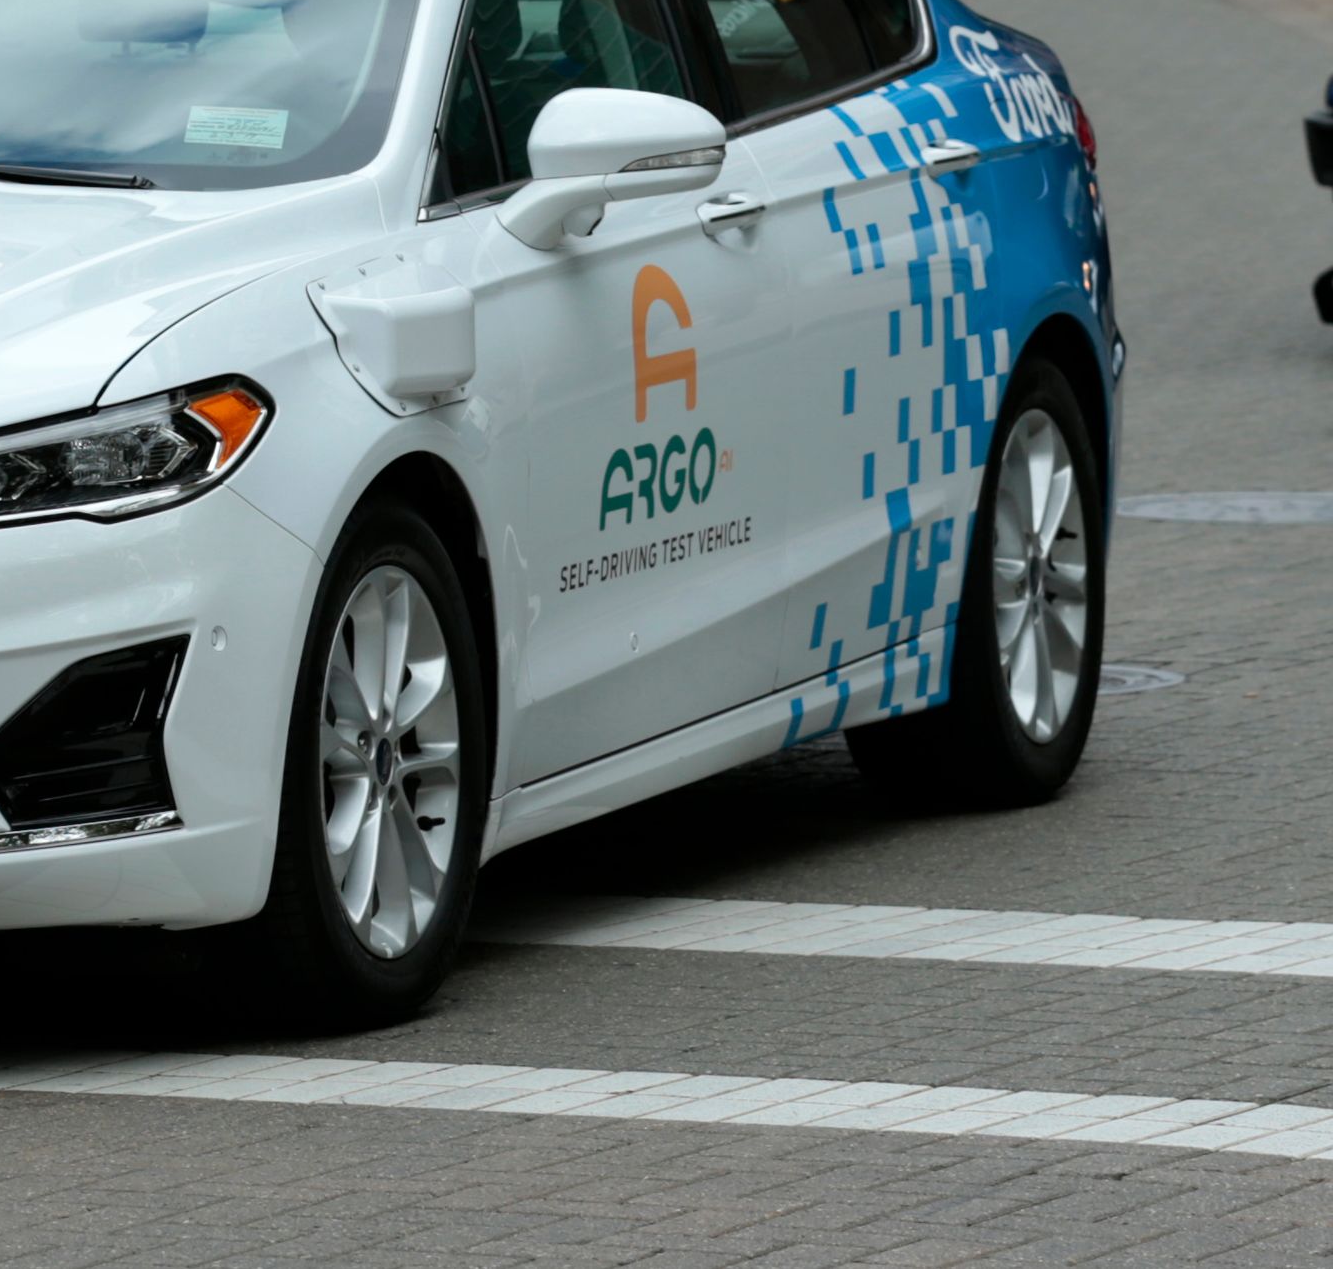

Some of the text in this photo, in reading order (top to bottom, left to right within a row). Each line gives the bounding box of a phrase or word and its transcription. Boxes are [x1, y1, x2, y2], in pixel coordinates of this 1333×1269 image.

[948, 25, 1076, 143] Ford
[598, 426, 717, 531] ARGO
[559, 516, 752, 593] SELF-DRIVING TEST VEHICLE
